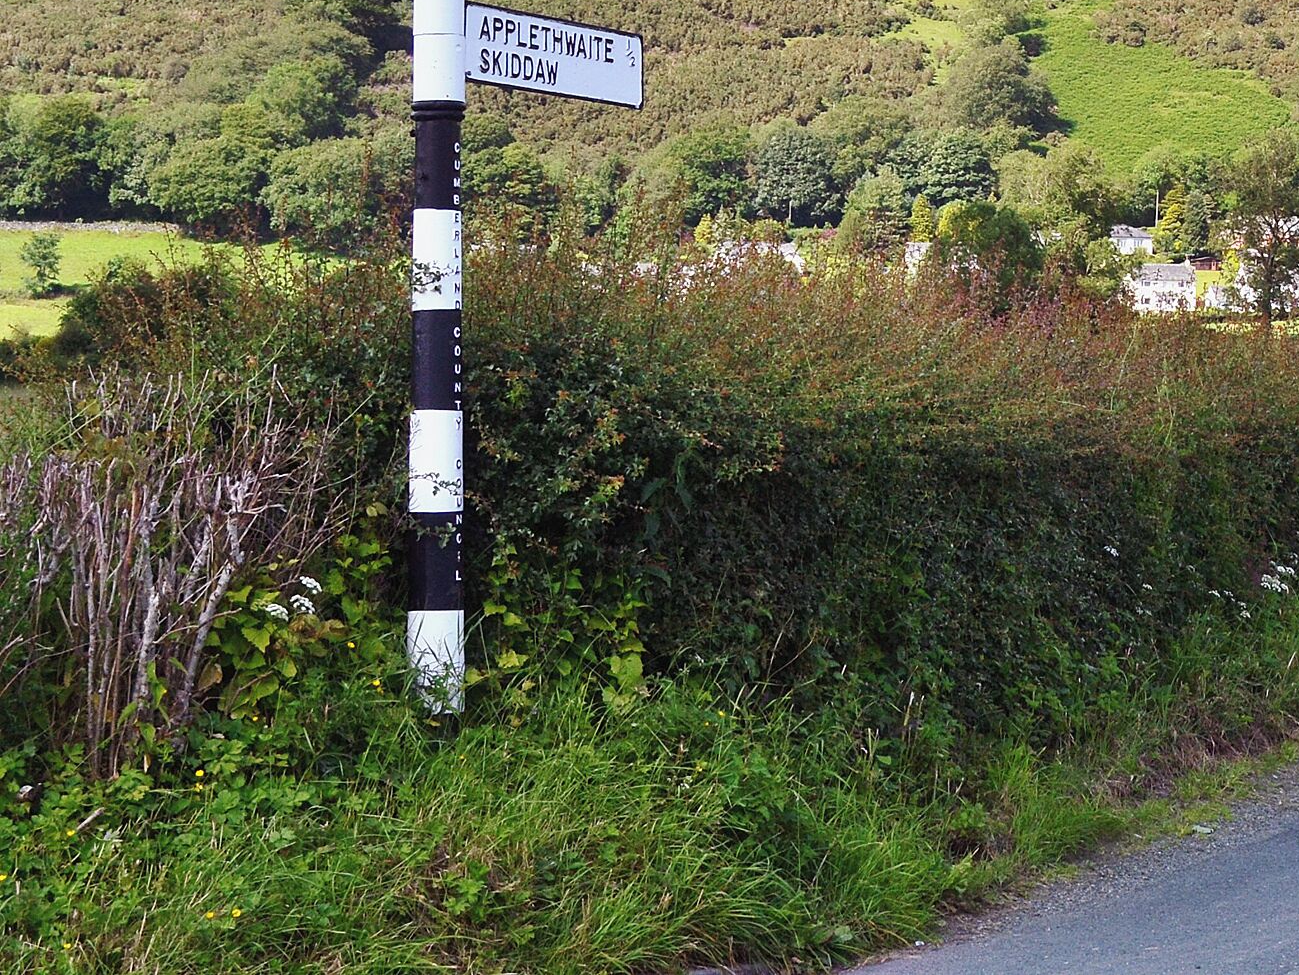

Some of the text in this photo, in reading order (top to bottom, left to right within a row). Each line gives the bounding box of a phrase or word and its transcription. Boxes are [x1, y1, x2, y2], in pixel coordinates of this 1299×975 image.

[479, 15, 614, 63] APPLETHWAITE
[479, 48, 559, 85] SKIDDAW
[453, 142, 461, 310] CUMBERLAND
[453, 326, 462, 431] COUNTY
